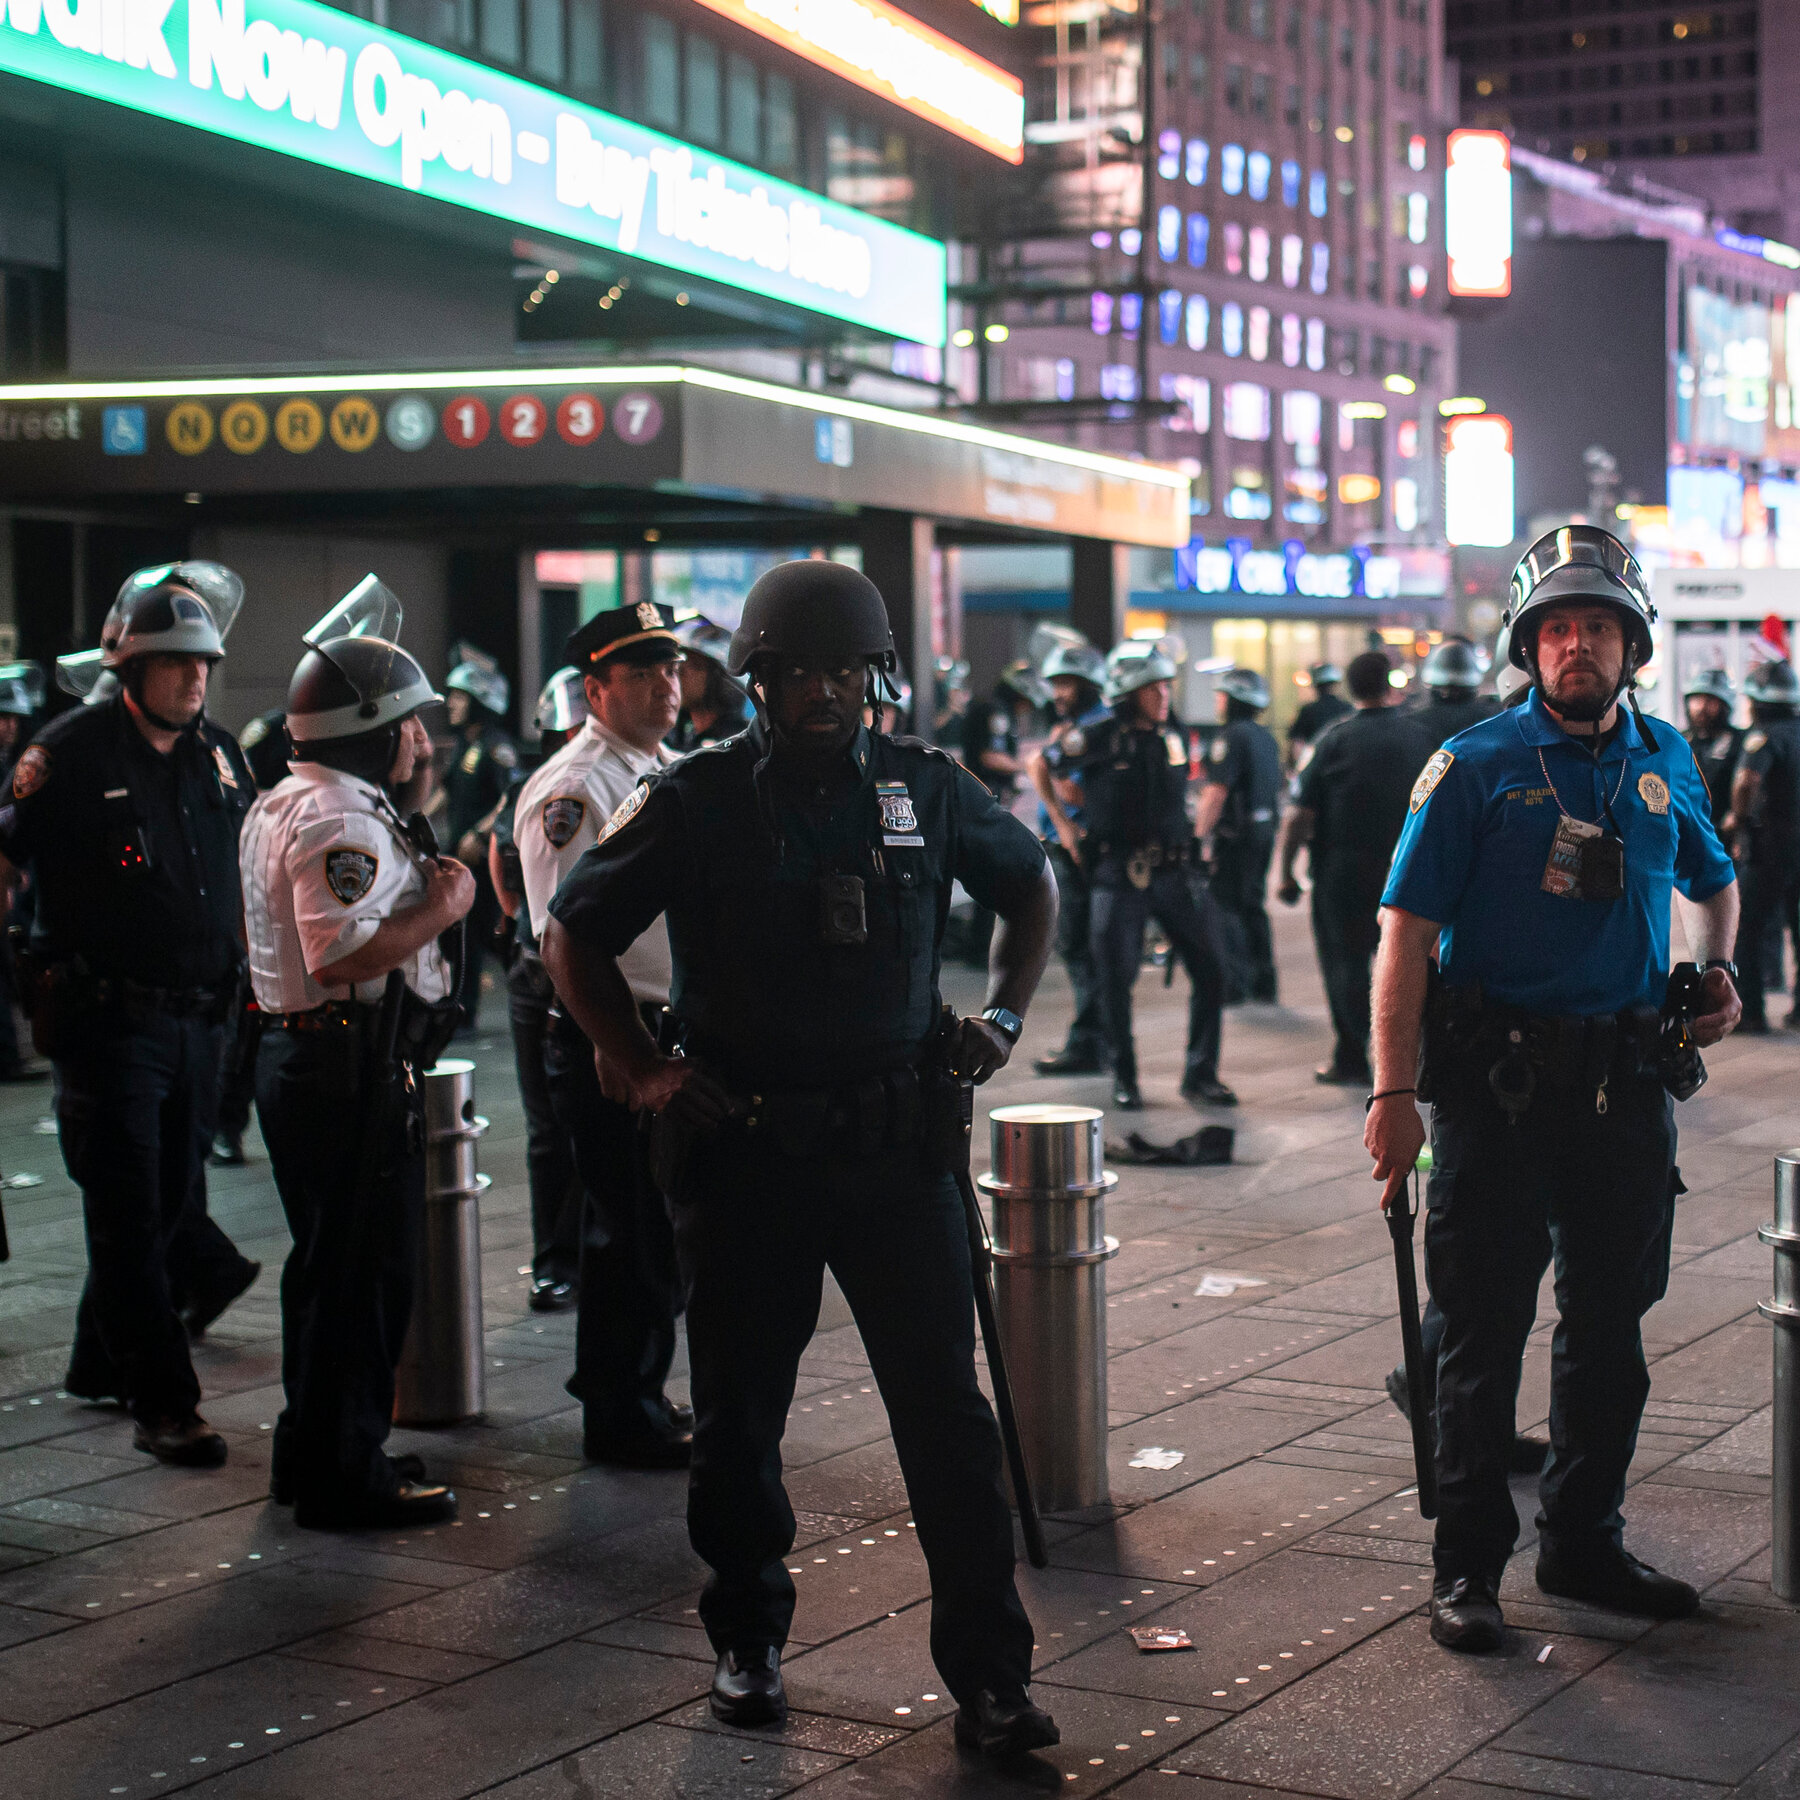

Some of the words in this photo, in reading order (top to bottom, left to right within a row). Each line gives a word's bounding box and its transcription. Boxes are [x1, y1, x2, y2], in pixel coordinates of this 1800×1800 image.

[188, 0, 347, 130] Now
[353, 43, 512, 191] Open
[176, 415, 201, 442] N
[287, 411, 310, 440] R
[336, 410, 371, 440] W
[397, 402, 424, 441] S
[455, 403, 476, 439] 1
[512, 402, 538, 438] 2
[568, 400, 595, 437] 3
[625, 400, 650, 435] 7
